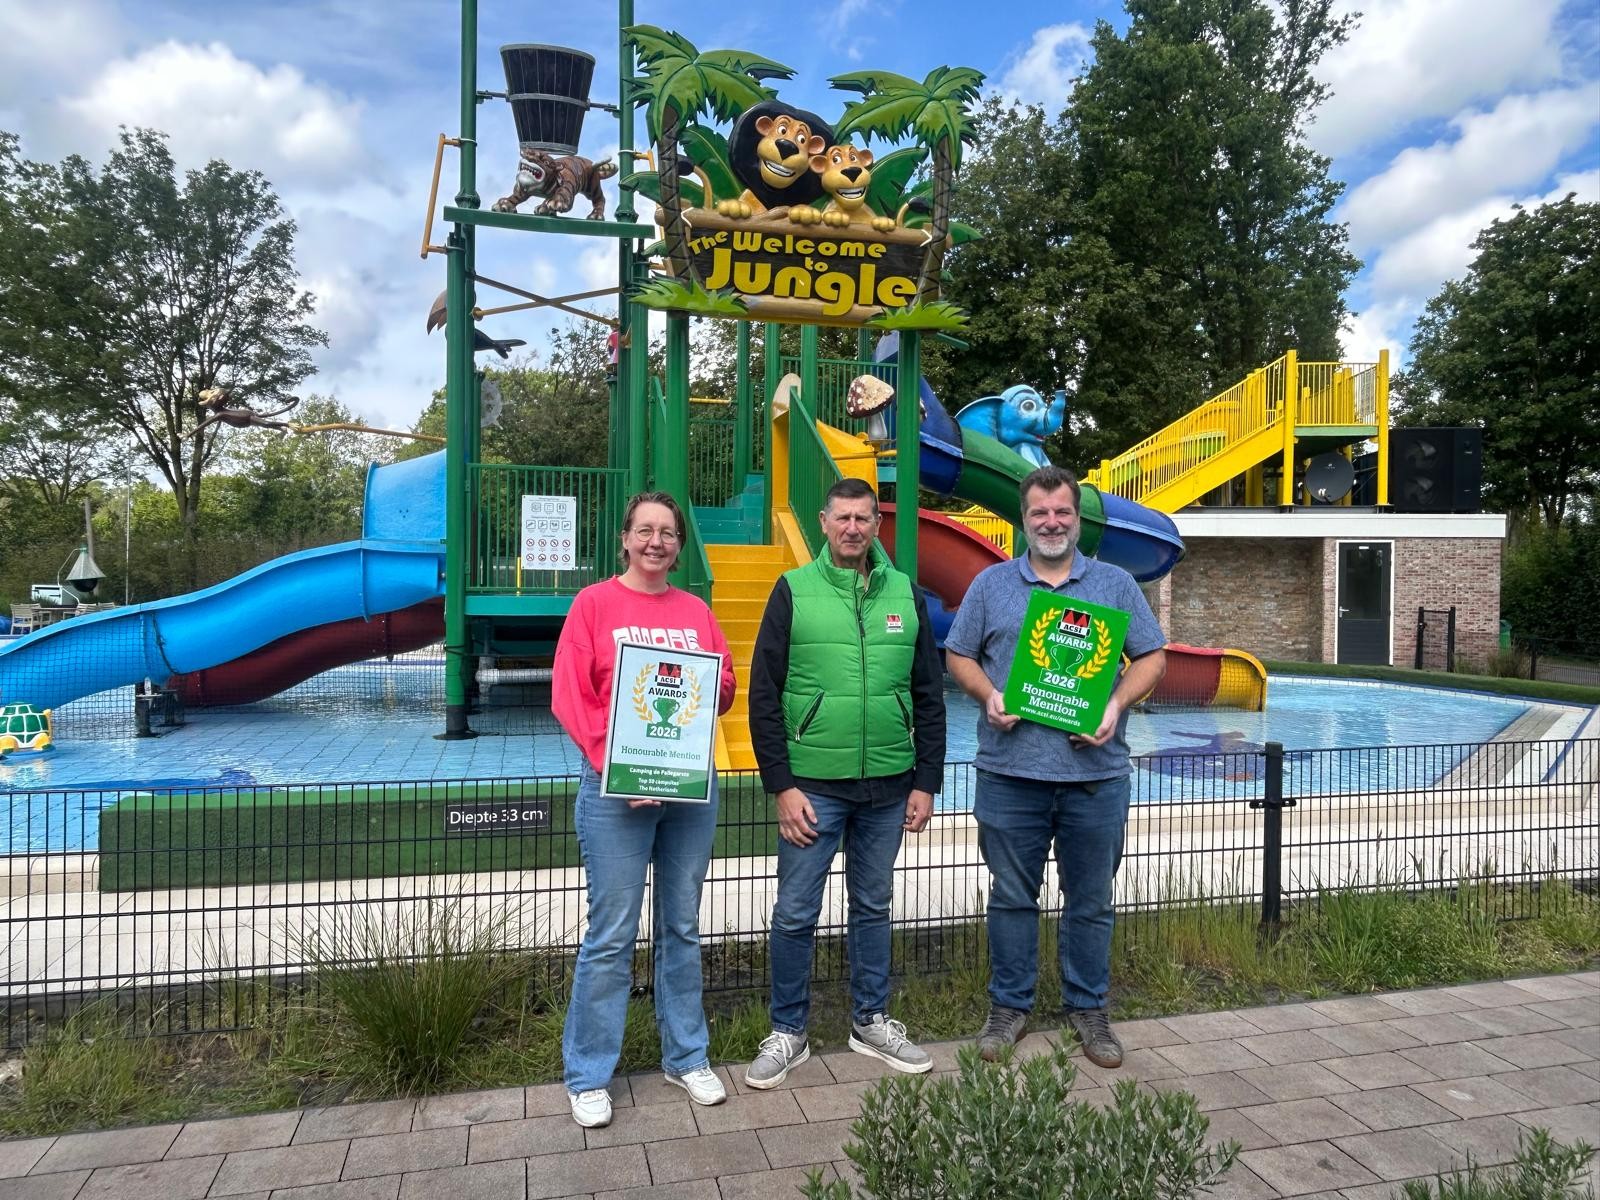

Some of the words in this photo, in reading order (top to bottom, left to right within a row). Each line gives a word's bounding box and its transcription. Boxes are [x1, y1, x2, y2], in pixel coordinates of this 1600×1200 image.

[688, 231, 728, 255] The
[733, 232, 886, 258] Welcome
[805, 256, 828, 272] to
[706, 248, 918, 316] Jungle
[1064, 624, 1082, 634] ACSI
[1048, 633, 1093, 650] AWARDS
[1043, 672, 1076, 689] 2026
[648, 687, 688, 698] AWARDS
[1022, 682, 1090, 709] Honourable
[1028, 696, 1076, 717] Mention
[1020, 706, 1080, 726] www.acsi.eu/awards
[650, 726, 678, 737] 2026
[621, 746, 667, 757] Honourable
[669, 751, 701, 760] Mention
[630, 767, 652, 776] Camping
[450, 811, 497, 826] Diepte
[501, 809, 518, 822] 33
[522, 810, 542, 820] cm
